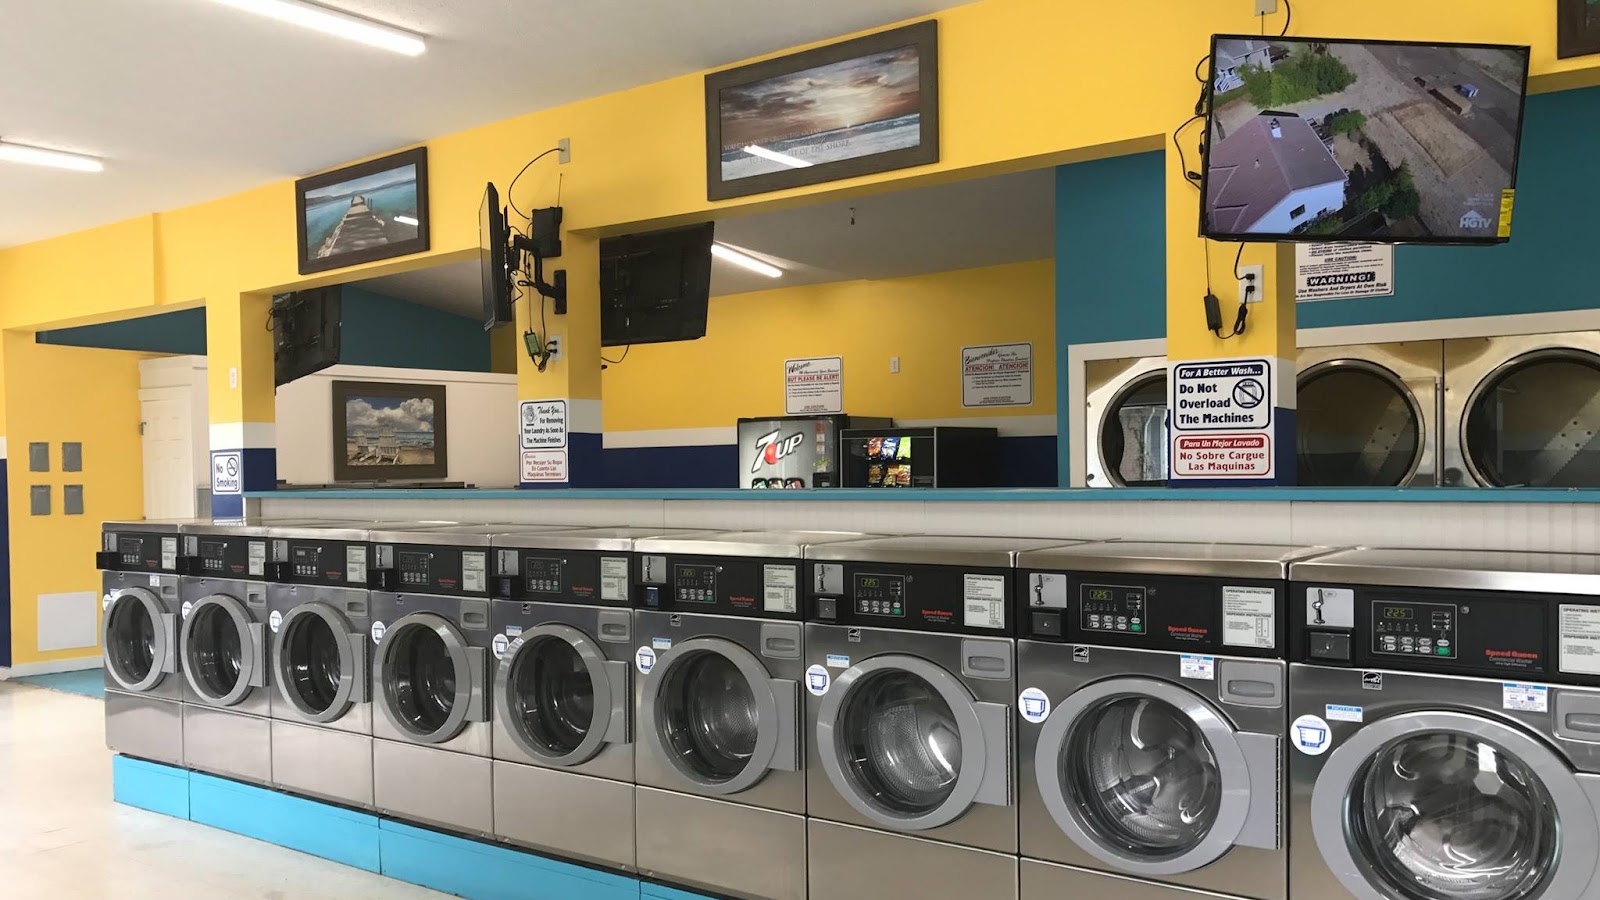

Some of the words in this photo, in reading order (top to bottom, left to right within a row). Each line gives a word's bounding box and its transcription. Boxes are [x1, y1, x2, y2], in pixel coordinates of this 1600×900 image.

[1460, 215, 1492, 228] HGTV
[1309, 273, 1370, 285] WARNING!
[1231, 367, 1261, 375] Wash...
[1180, 385, 1194, 394] Do
[1198, 384, 1217, 393] Not
[1180, 398, 1230, 408] Overload
[538, 406, 550, 414] Thank
[1180, 414, 1199, 424] The
[1203, 413, 1254, 423] Machines
[1229, 452, 1265, 461] Cargue
[216, 463, 223, 474] No
[1208, 462, 1255, 472] Maquinas
[217, 477, 237, 490] Smoking
[1512, 650, 1538, 658] Queen
